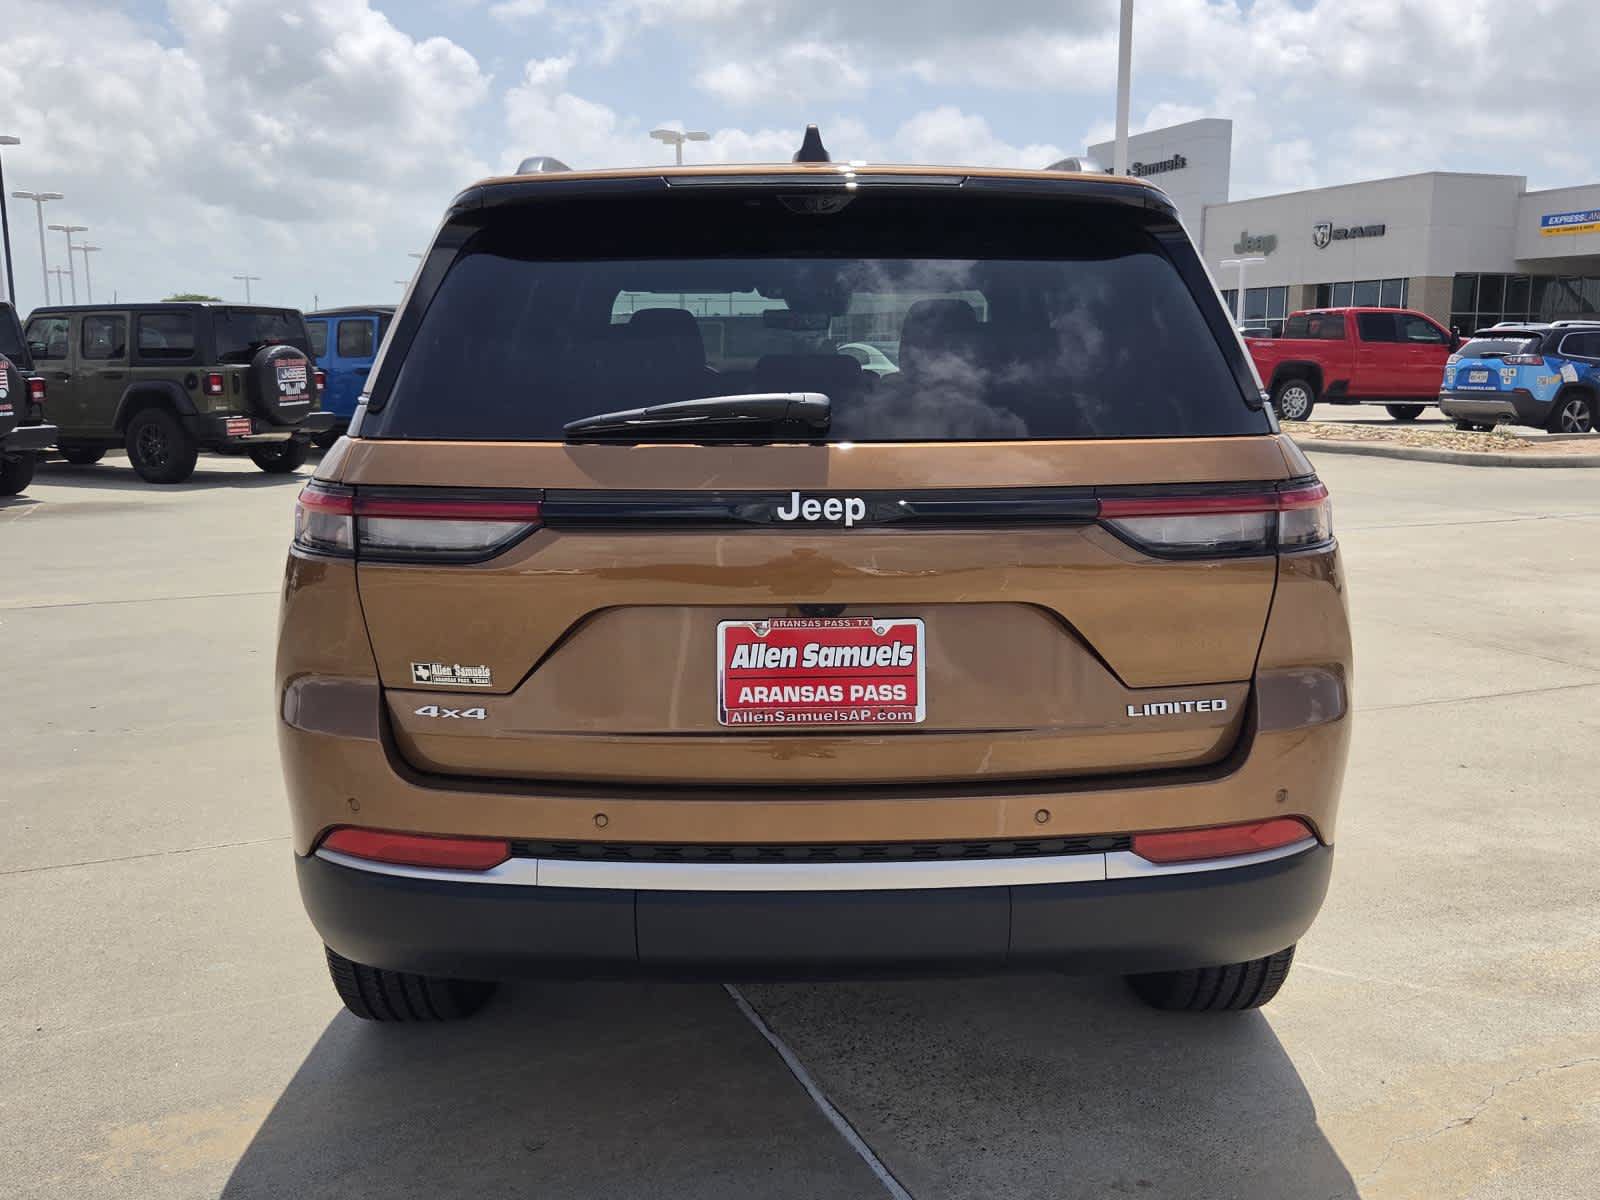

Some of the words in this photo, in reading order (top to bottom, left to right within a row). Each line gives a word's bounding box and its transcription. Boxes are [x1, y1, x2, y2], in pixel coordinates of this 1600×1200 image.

[1332, 224, 1386, 241] RAM
[1233, 230, 1278, 256] Jeep
[777, 491, 866, 527] Jeep
[772, 620, 821, 628] ARANSAS
[730, 643, 797, 669] Allen
[801, 641, 914, 668] Samuels
[431, 664, 453, 675] Allen
[453, 664, 490, 676] Samuels
[738, 685, 844, 703] ARANSAS
[849, 684, 907, 702] PASS
[414, 706, 487, 720] 4x4
[731, 709, 913, 723] AllenSamuelsAP.com
[1127, 699, 1228, 717] LIMITED
